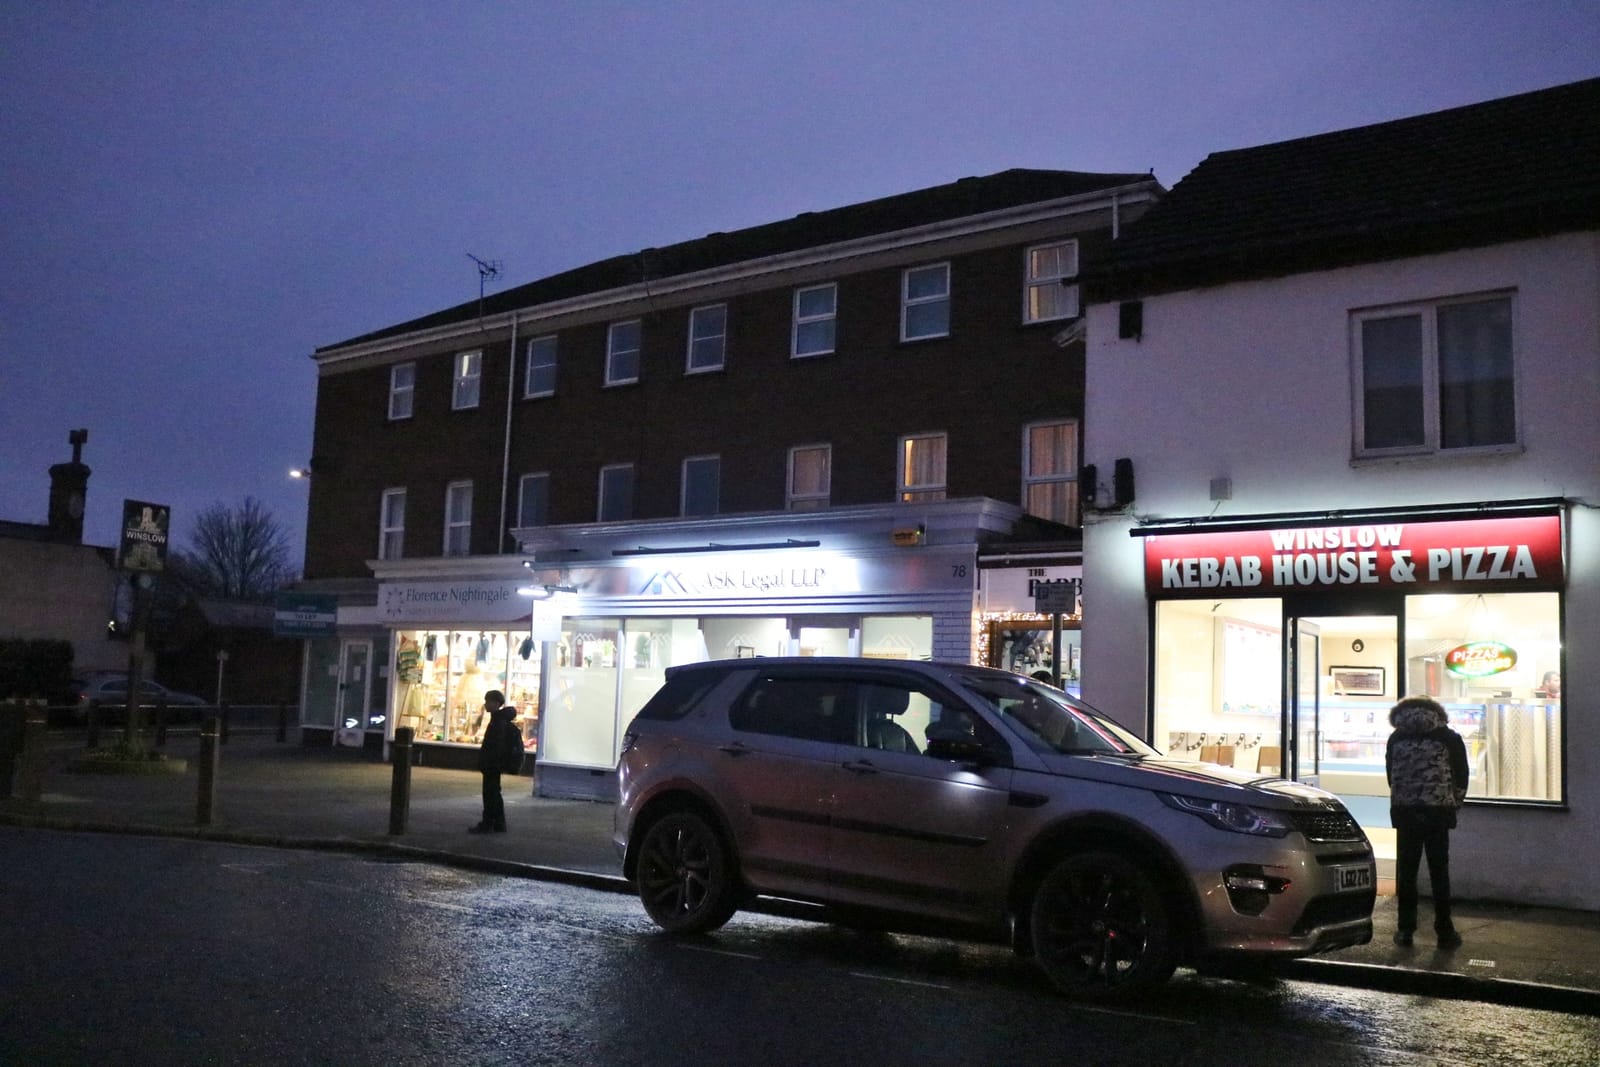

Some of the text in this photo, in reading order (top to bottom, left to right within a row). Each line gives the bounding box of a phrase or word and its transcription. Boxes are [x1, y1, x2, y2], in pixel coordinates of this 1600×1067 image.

[126, 530, 166, 543] WINSLOW
[1270, 526, 1403, 551] WINSLOW
[951, 564, 967, 578] 78
[1028, 568, 1047, 577] THE
[1161, 545, 1538, 588] KEBAB HOUSE & PIZZA
[742, 569, 785, 592] Legal
[791, 567, 825, 587] LLP
[406, 588, 448, 601] Florence
[451, 586, 509, 605] Nightingale
[1452, 648, 1498, 662] PIZZAS
